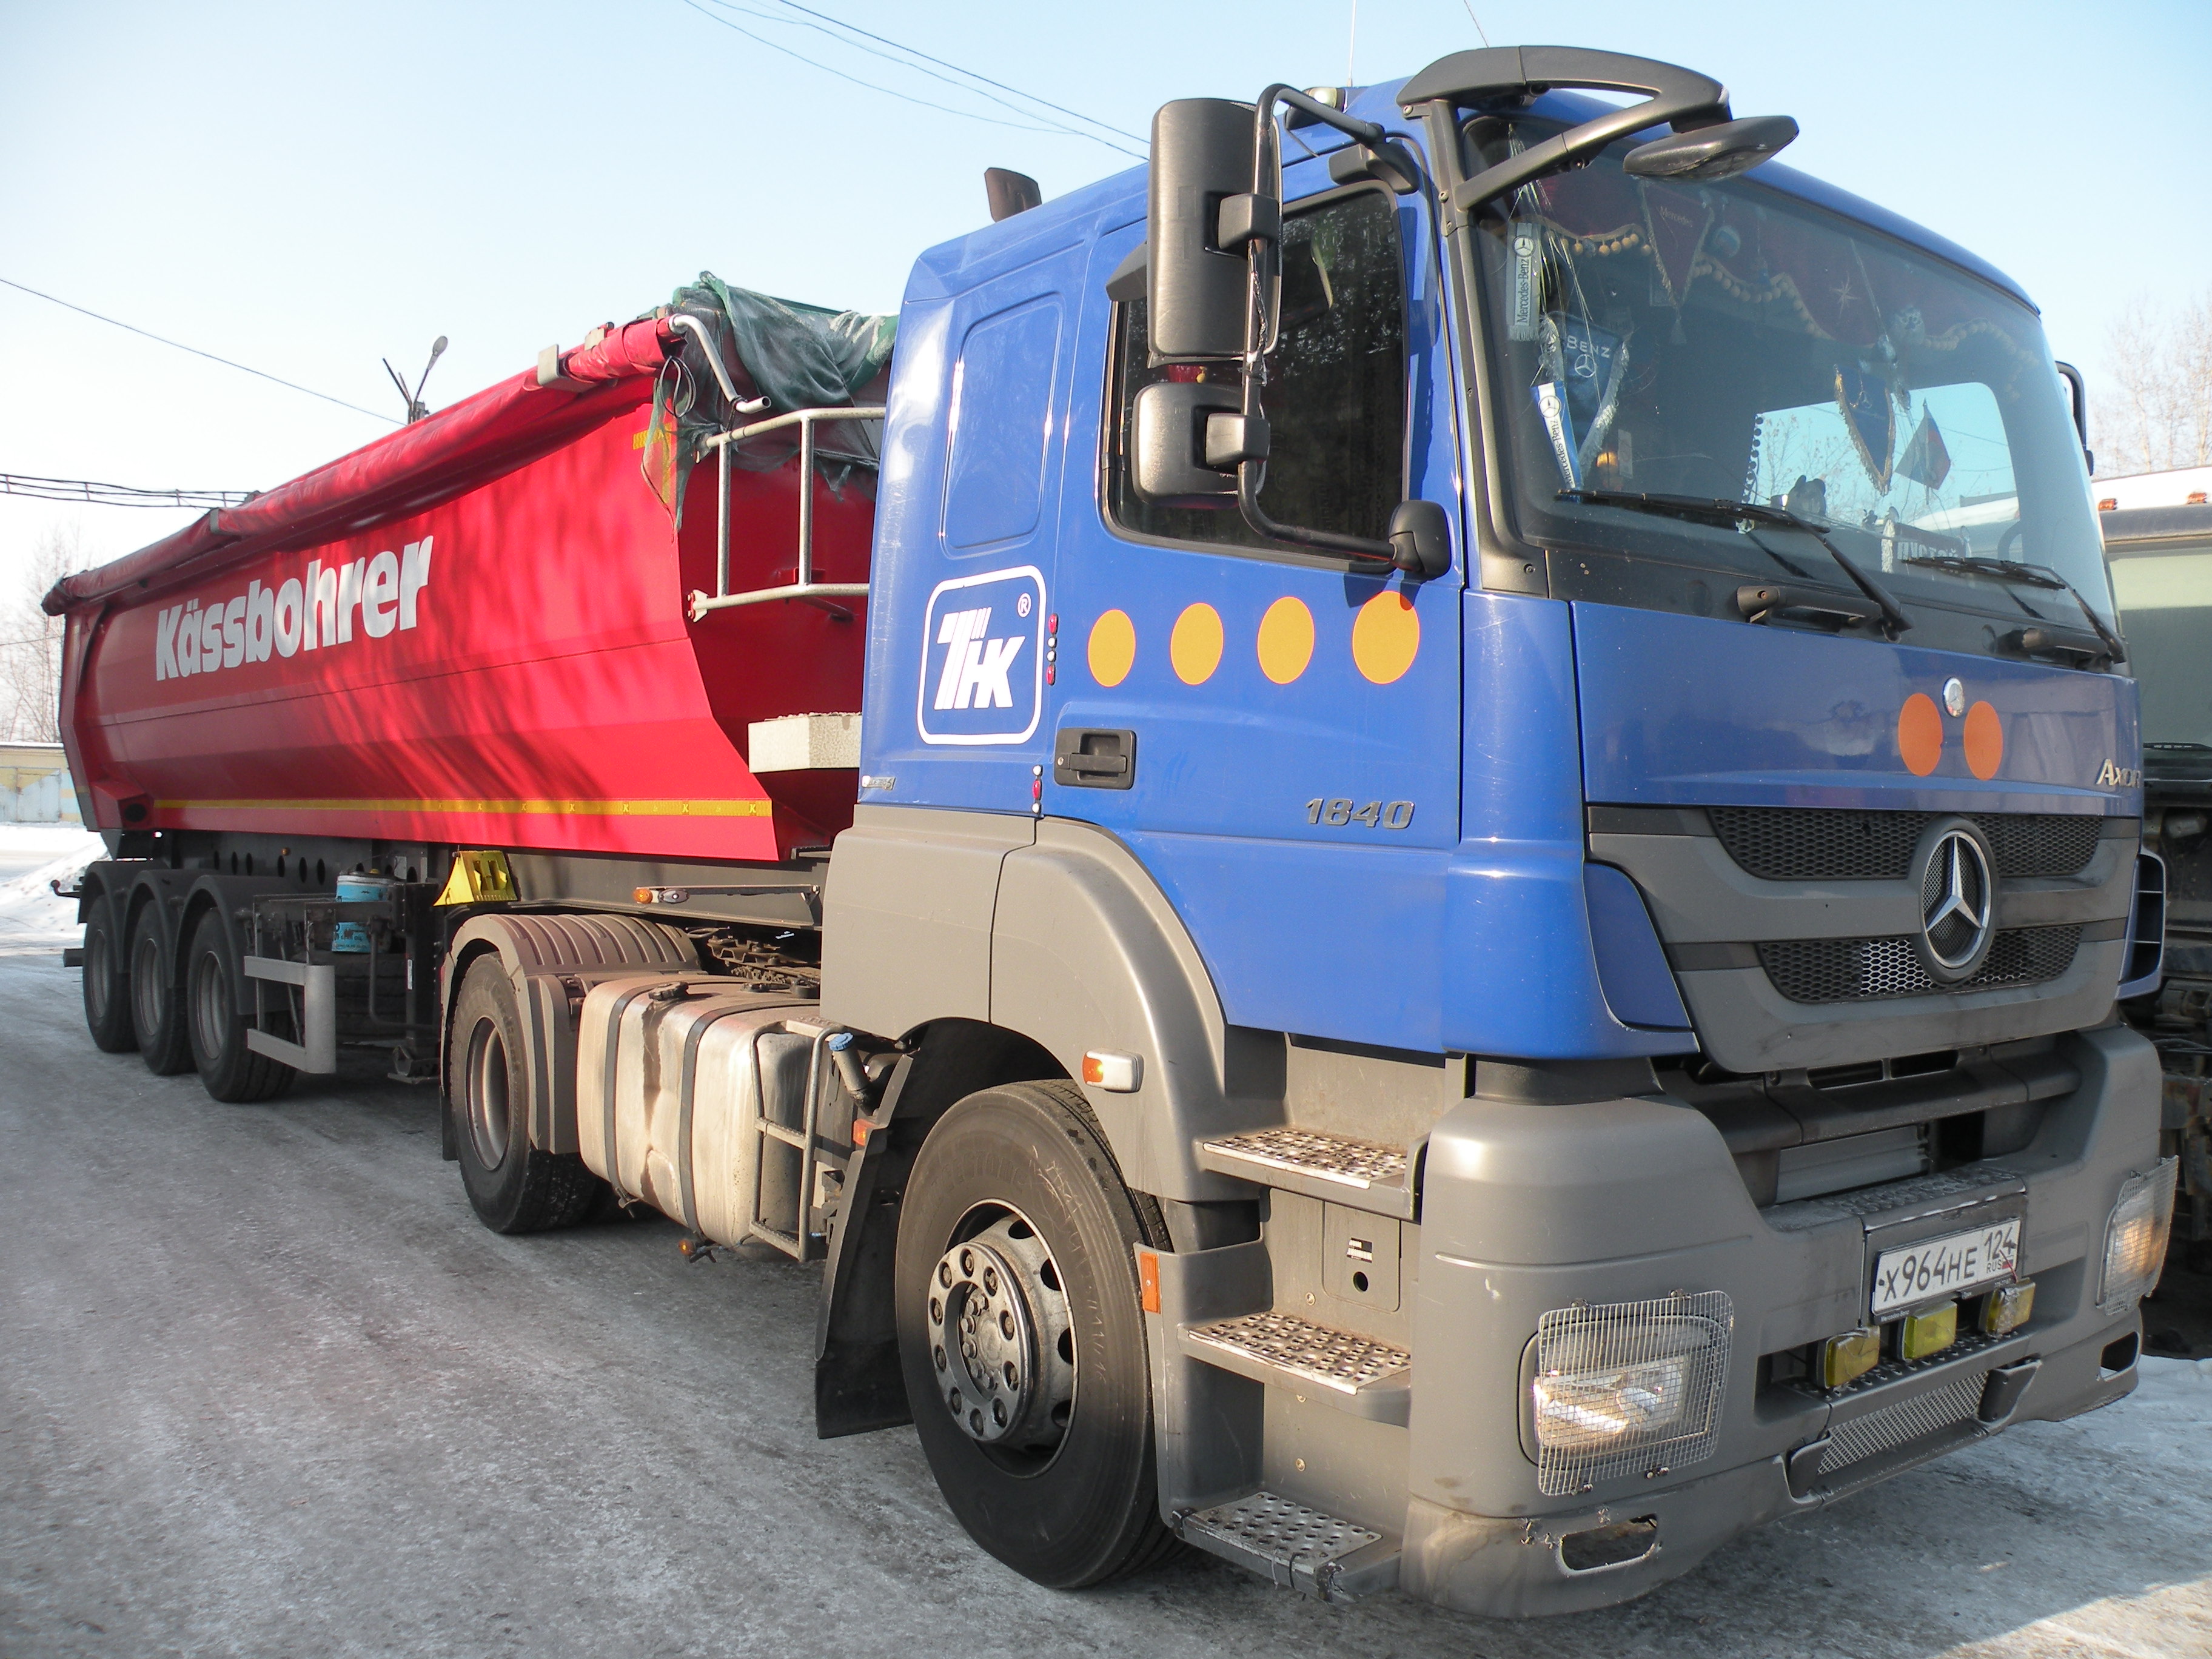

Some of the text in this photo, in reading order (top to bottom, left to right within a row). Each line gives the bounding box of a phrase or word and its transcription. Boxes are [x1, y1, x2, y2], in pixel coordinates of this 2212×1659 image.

[1517, 258, 1529, 323] Mercedes-Benz
[1567, 335, 1610, 359] BENZ
[1550, 419, 1573, 486] Mercedes-Benz
[156, 535, 434, 681] Kässbohrer
[1305, 797, 1416, 830] 1840
[1984, 1226, 2017, 1262] 124
[1986, 1259, 2003, 1274] RUS
